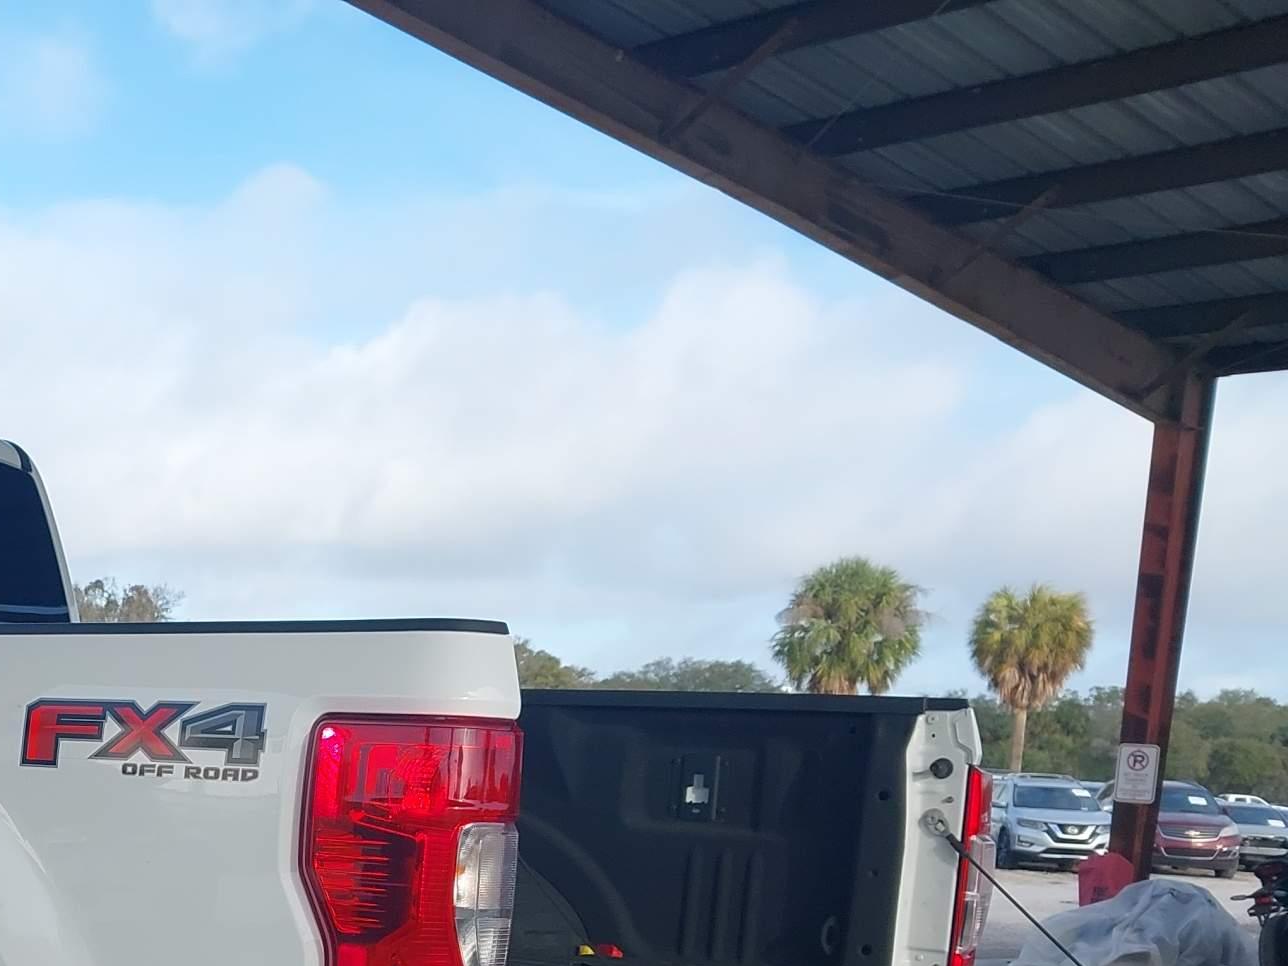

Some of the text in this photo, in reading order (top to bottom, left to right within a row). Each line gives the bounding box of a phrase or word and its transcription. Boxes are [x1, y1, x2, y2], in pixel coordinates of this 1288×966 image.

[19, 697, 267, 768] FX4
[121, 763, 259, 782] OFF ROAD
